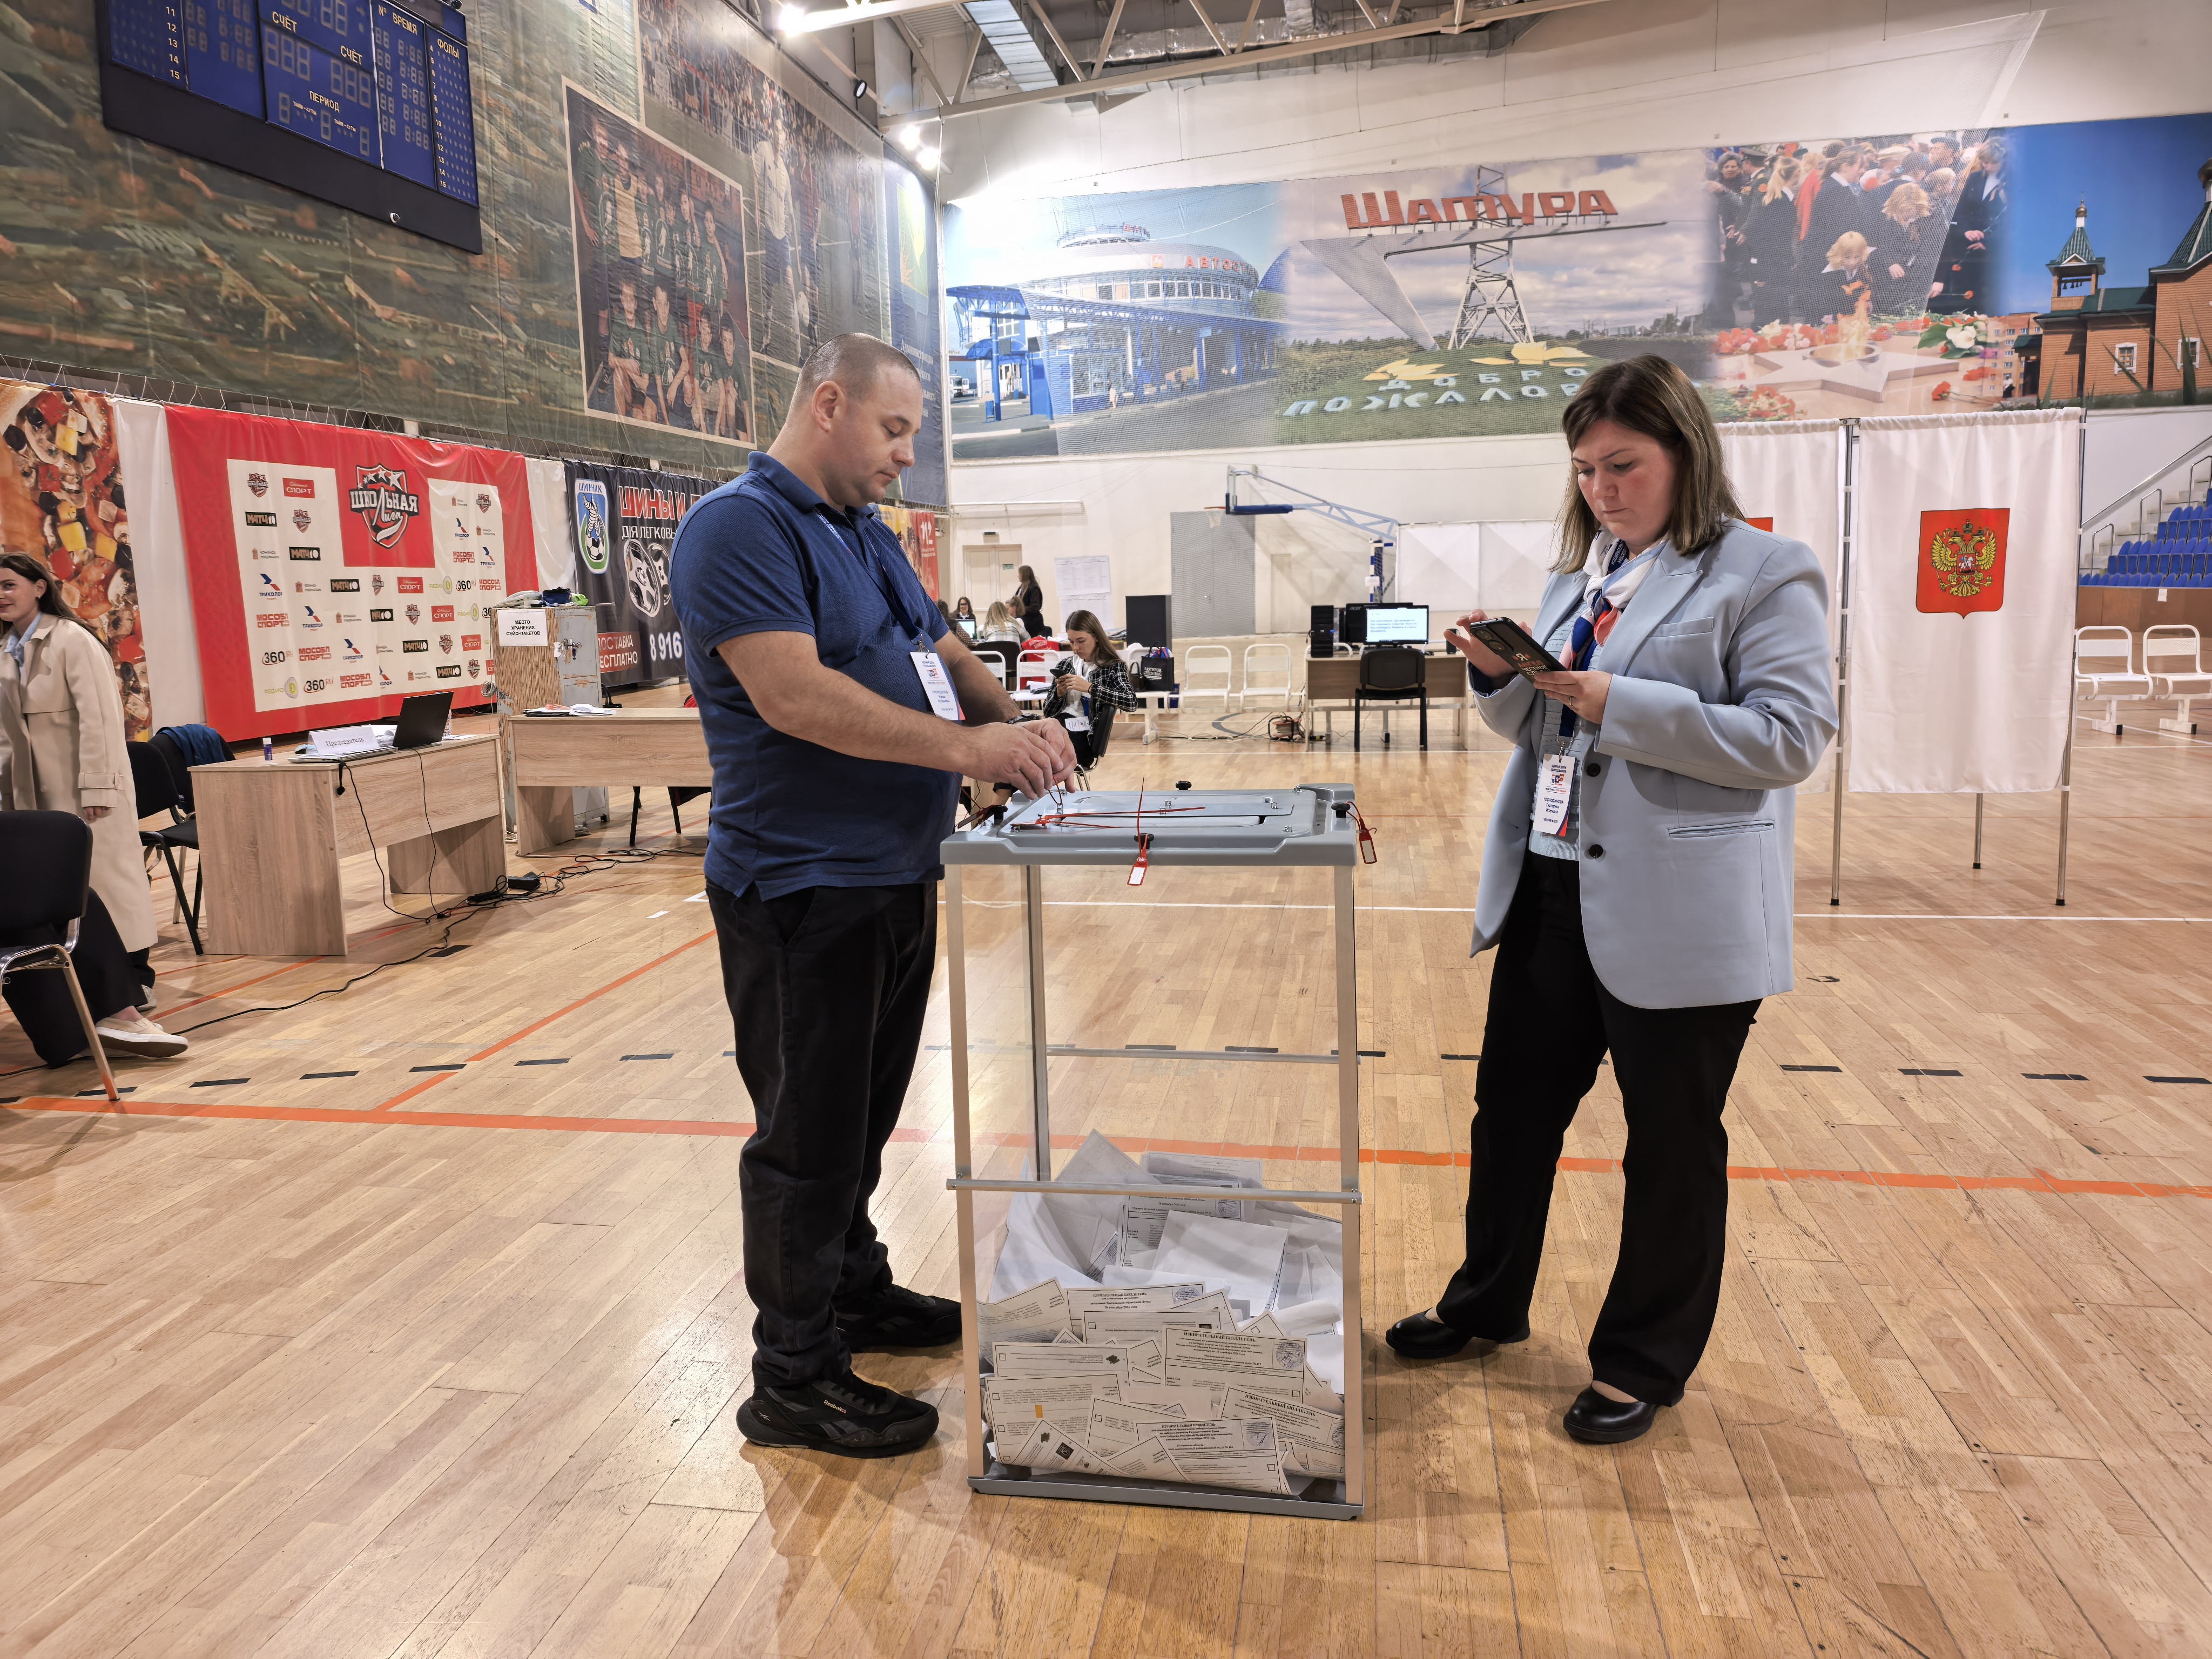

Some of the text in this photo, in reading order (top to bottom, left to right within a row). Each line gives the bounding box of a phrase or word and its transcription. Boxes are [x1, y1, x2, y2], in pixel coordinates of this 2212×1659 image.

[166, 6, 175, 17] 11
[167, 22, 177, 32] 12
[392, 12, 418, 35] ВРЕМЯ
[168, 38, 178, 48] 13
[437, 38, 460, 59] ФОЛЫ
[169, 54, 179, 64] 14
[170, 70, 180, 79] 15
[309, 90, 340, 113] ПЕРИОД
[435, 119, 442, 127] 10
[437, 144, 444, 152] 12
[1379, 368, 1589, 391] ДОБРО
[1283, 382, 1581, 417] ПОЖАЛОВ
[350, 490, 418, 513] ШКОЛЬНАЯ
[618, 485, 675, 520] ШИНЫ
[639, 526, 676, 539] ЛЕГКОВ
[1610, 541, 1624, 565] ИЗБИРАТЕ
[457, 580, 471, 590] 360
[650, 631, 683, 662] 8 916
[265, 651, 285, 664] 360
[599, 651, 638, 669] ЕСПЛАТНО
[1516, 653, 1528, 661] Я
[306, 679, 325, 691] 360
[325, 738, 365, 747] Председатель
[1184, 1332, 1225, 1340] ИЗБИРАТЕЛЬНЫЙ
[824, 1399, 843, 1412] Reebok
[1245, 1394, 1286, 1408] ИЗБИРАТЕЛЬНЫЙ
[1286, 1405, 1316, 1417] БЮЛЛЕТЕНЬ
